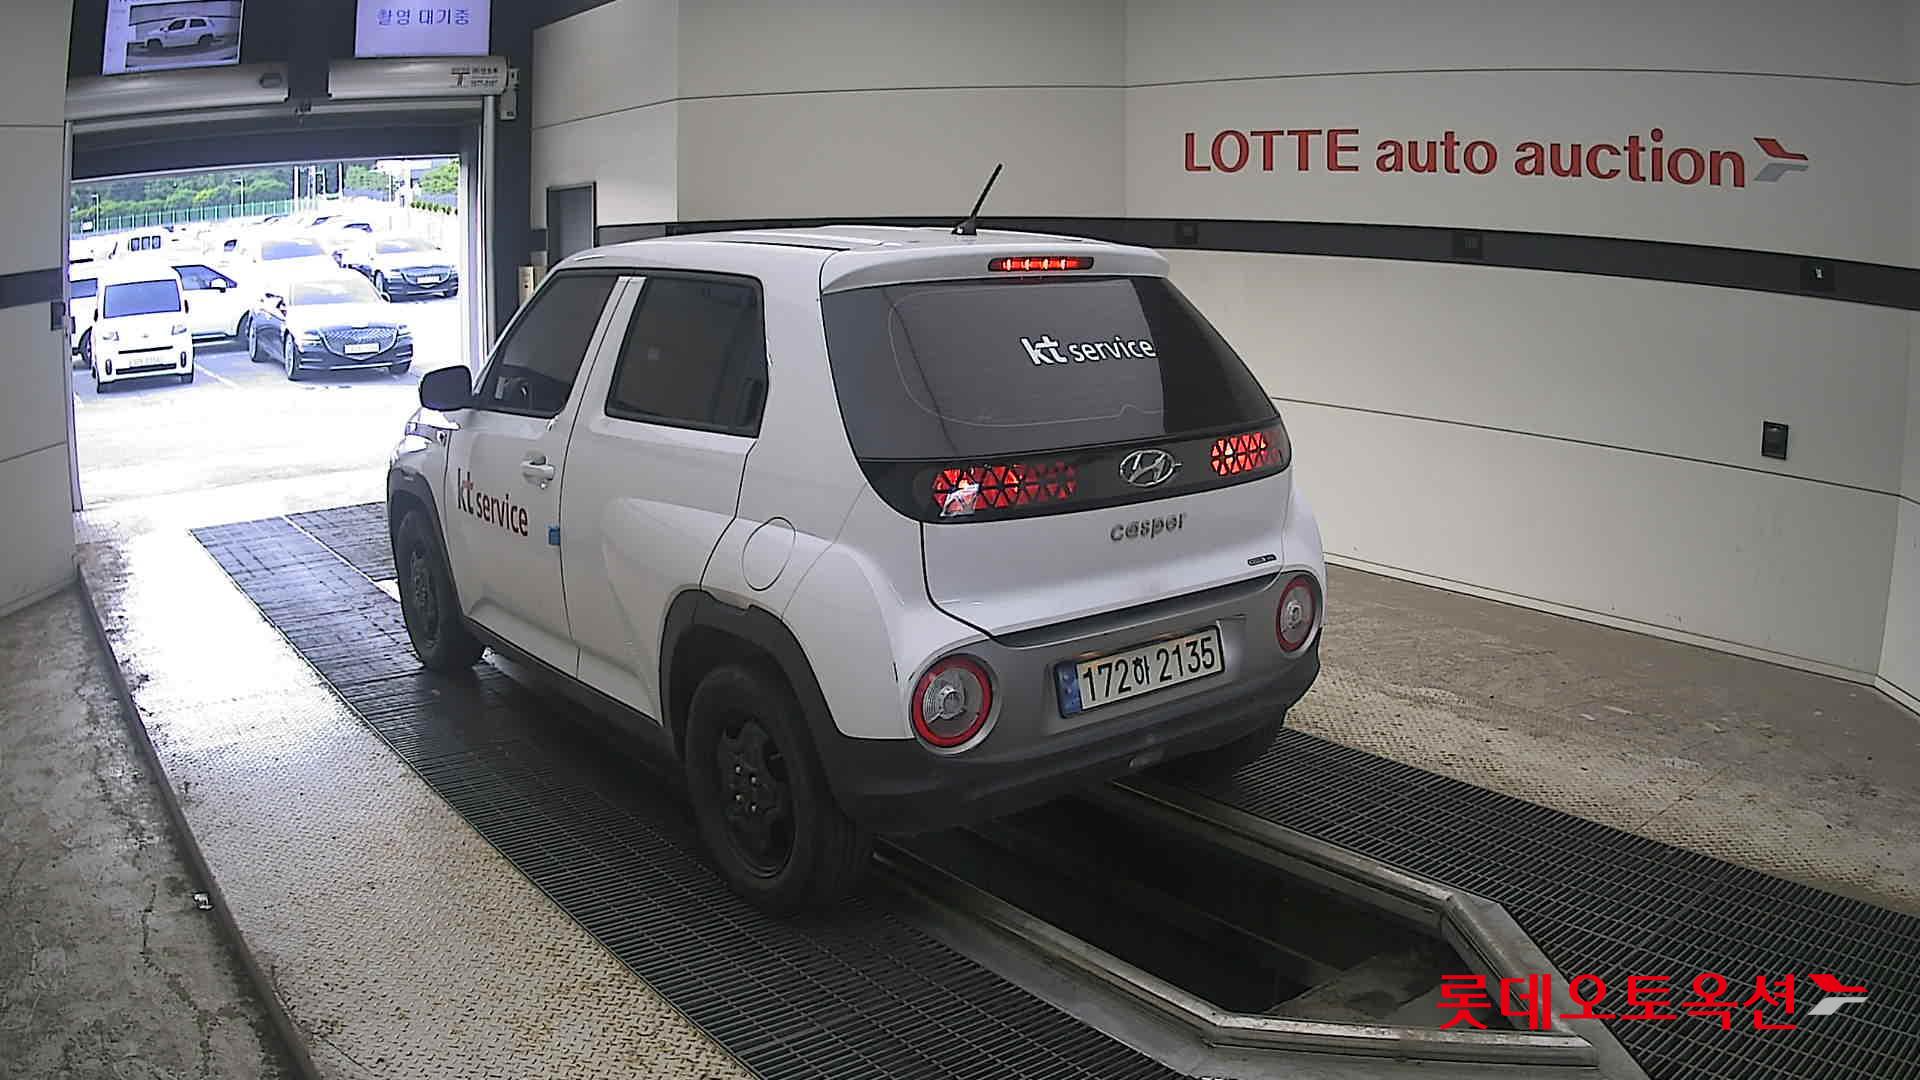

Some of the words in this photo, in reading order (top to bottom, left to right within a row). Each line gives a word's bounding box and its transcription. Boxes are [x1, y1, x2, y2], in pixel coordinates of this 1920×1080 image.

[419, 8, 470, 25] 대기중
[1185, 129, 1359, 173] LOTTE
[1376, 130, 1498, 176] auto
[1514, 128, 1746, 188] auction
[1020, 335, 1067, 365] kt
[1068, 336, 1157, 362] service
[457, 467, 474, 514] kt
[476, 492, 528, 536] service
[1156, 636, 1216, 684] 2135
